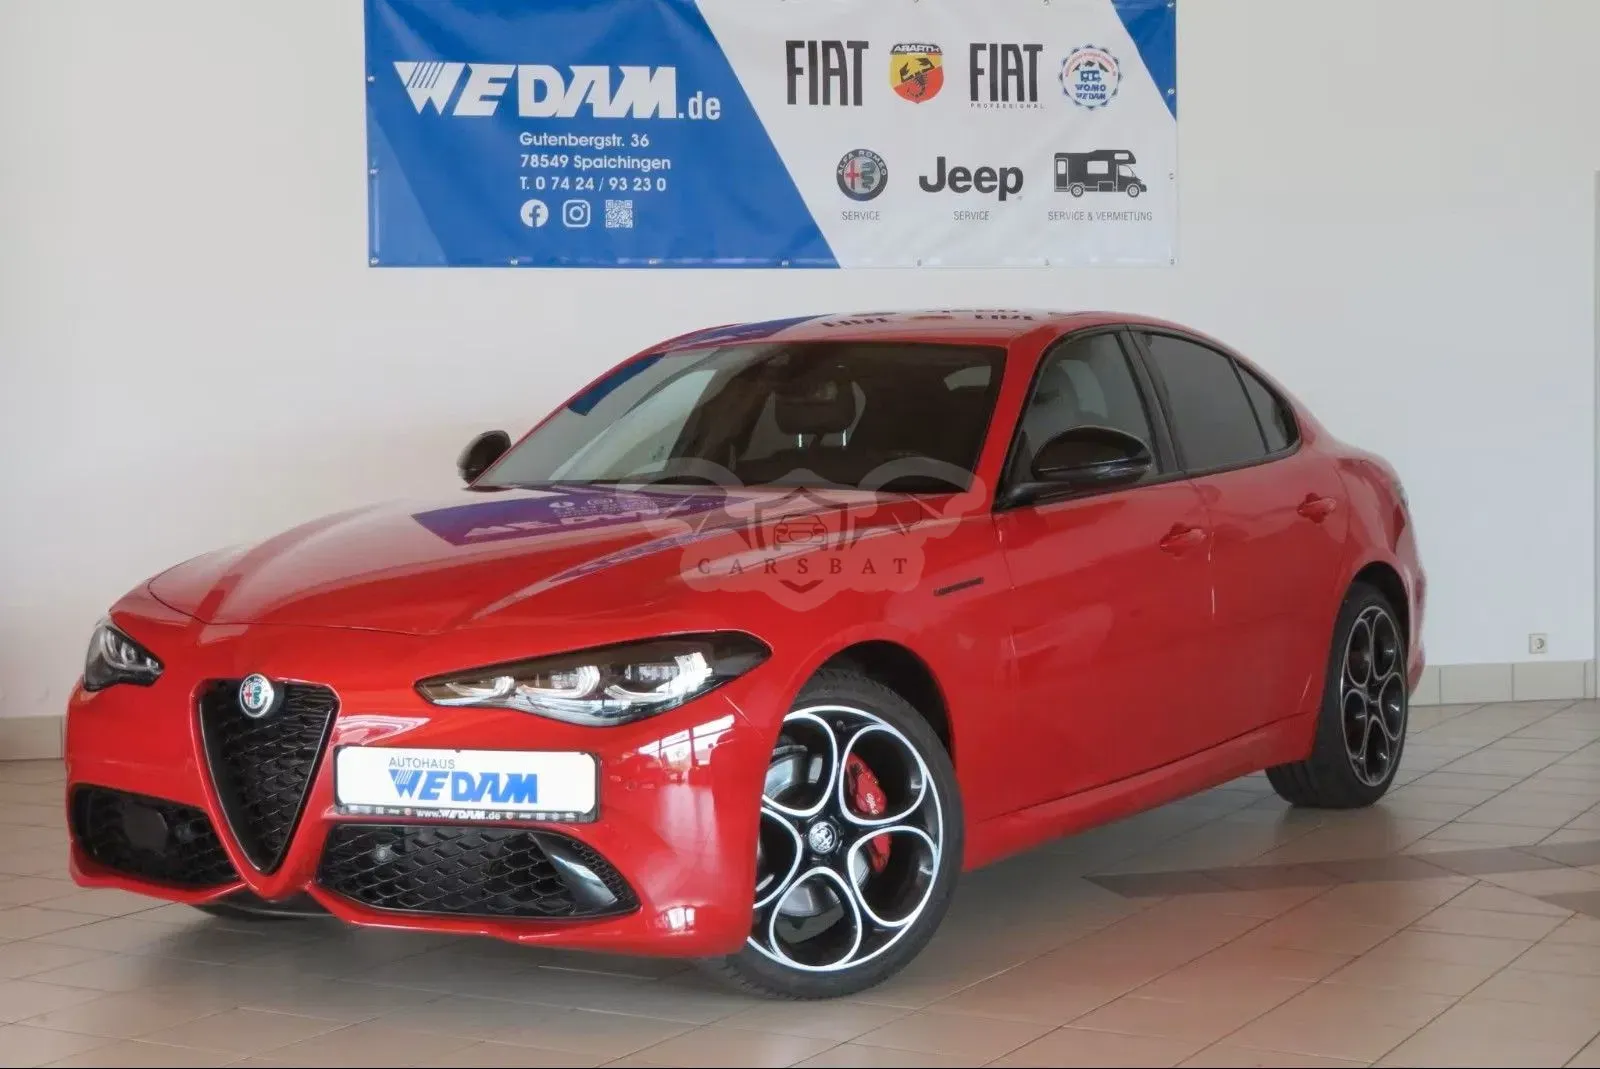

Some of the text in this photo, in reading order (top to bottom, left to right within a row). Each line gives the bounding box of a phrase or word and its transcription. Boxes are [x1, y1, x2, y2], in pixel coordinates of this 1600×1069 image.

[894, 44, 940, 53] ABARTH
[785, 40, 869, 106] FIAT
[969, 43, 1044, 102] FIAT
[393, 61, 721, 120] WEDAM.de
[519, 131, 650, 150] Gutenbergstr. 36
[520, 154, 672, 173] 78549 Spaichingen
[519, 176, 667, 192] T. 0 74 24 / 93 23 0
[918, 156, 1024, 201] Jeep
[841, 210, 881, 221] SERVICE
[953, 210, 990, 221] SERVICE
[1048, 210, 1153, 222] SERVICE & VERMIETUNG
[388, 756, 456, 770] AUTOHAUS
[388, 768, 538, 804] WEDAM
